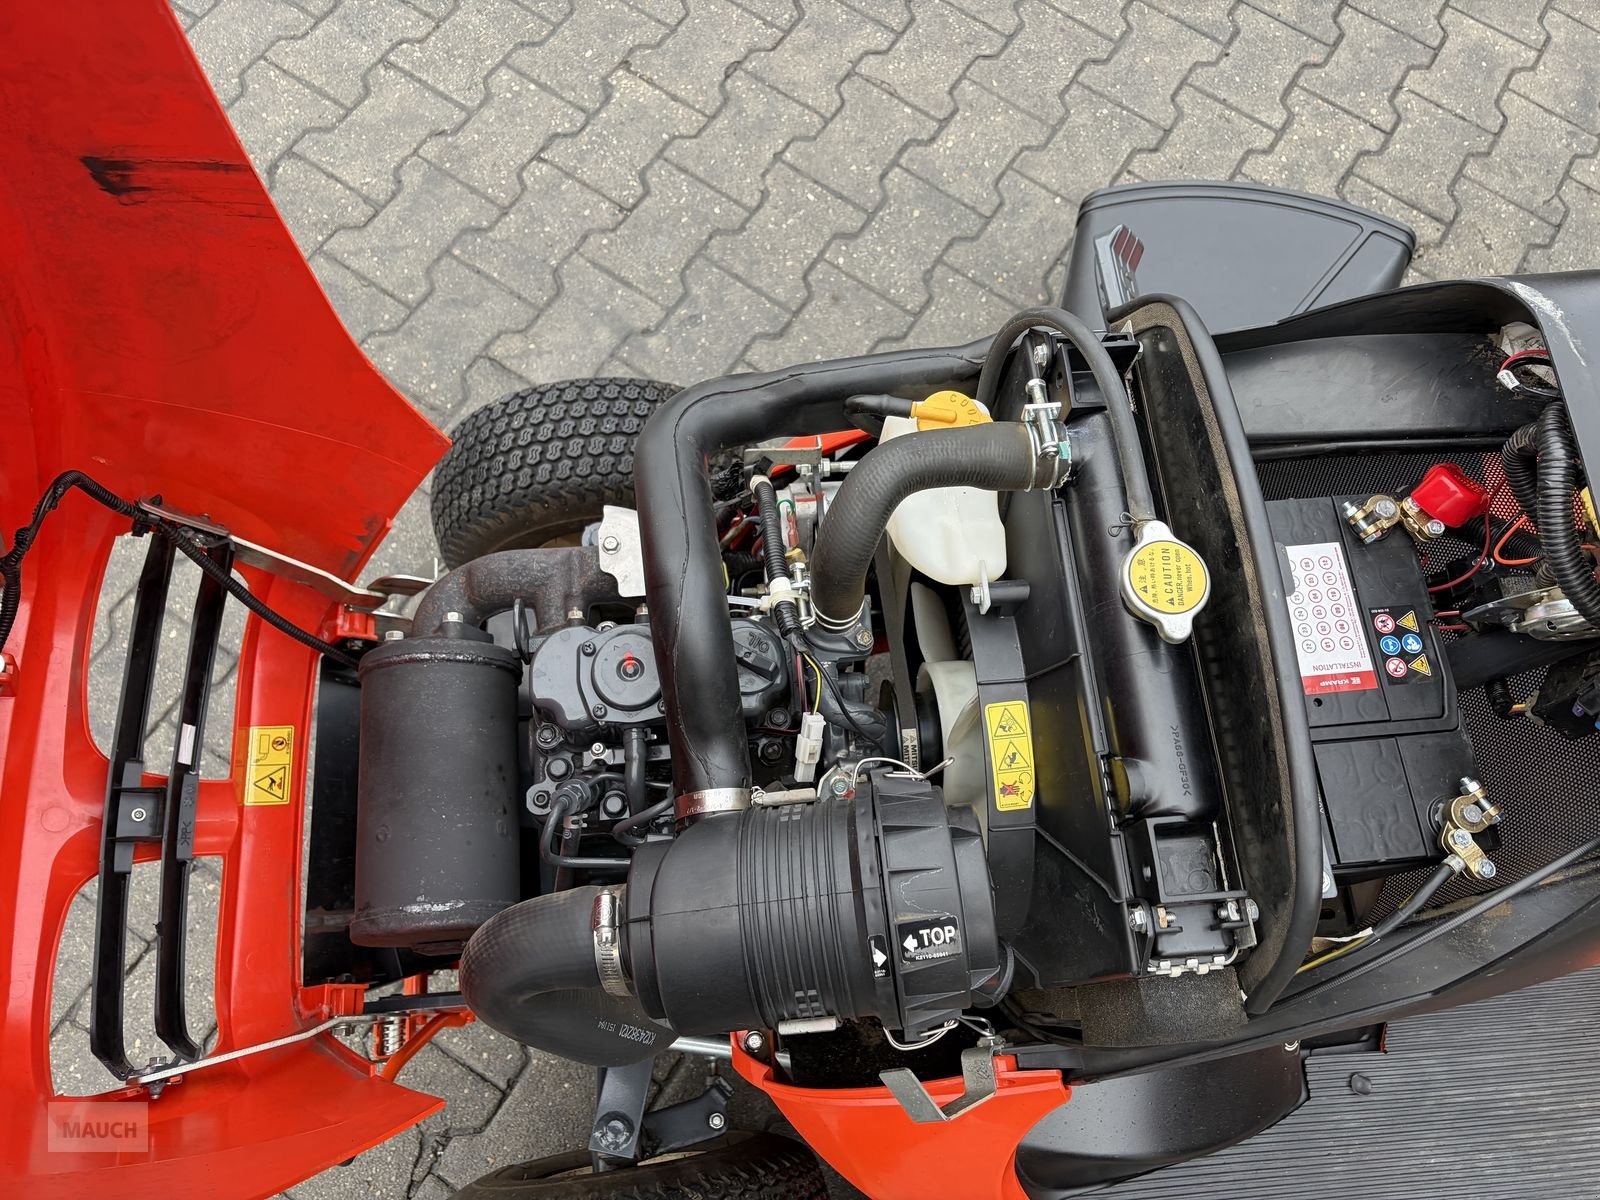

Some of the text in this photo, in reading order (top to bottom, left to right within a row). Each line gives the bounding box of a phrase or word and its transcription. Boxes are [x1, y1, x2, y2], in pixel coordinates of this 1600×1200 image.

[949, 393, 979, 424] COOL
[1161, 547, 1174, 594] CAUTION
[749, 631, 769, 654] OIL
[1312, 661, 1361, 672] INSTALLATION
[1320, 678, 1349, 687] KRAMP
[918, 925, 956, 947] TOP
